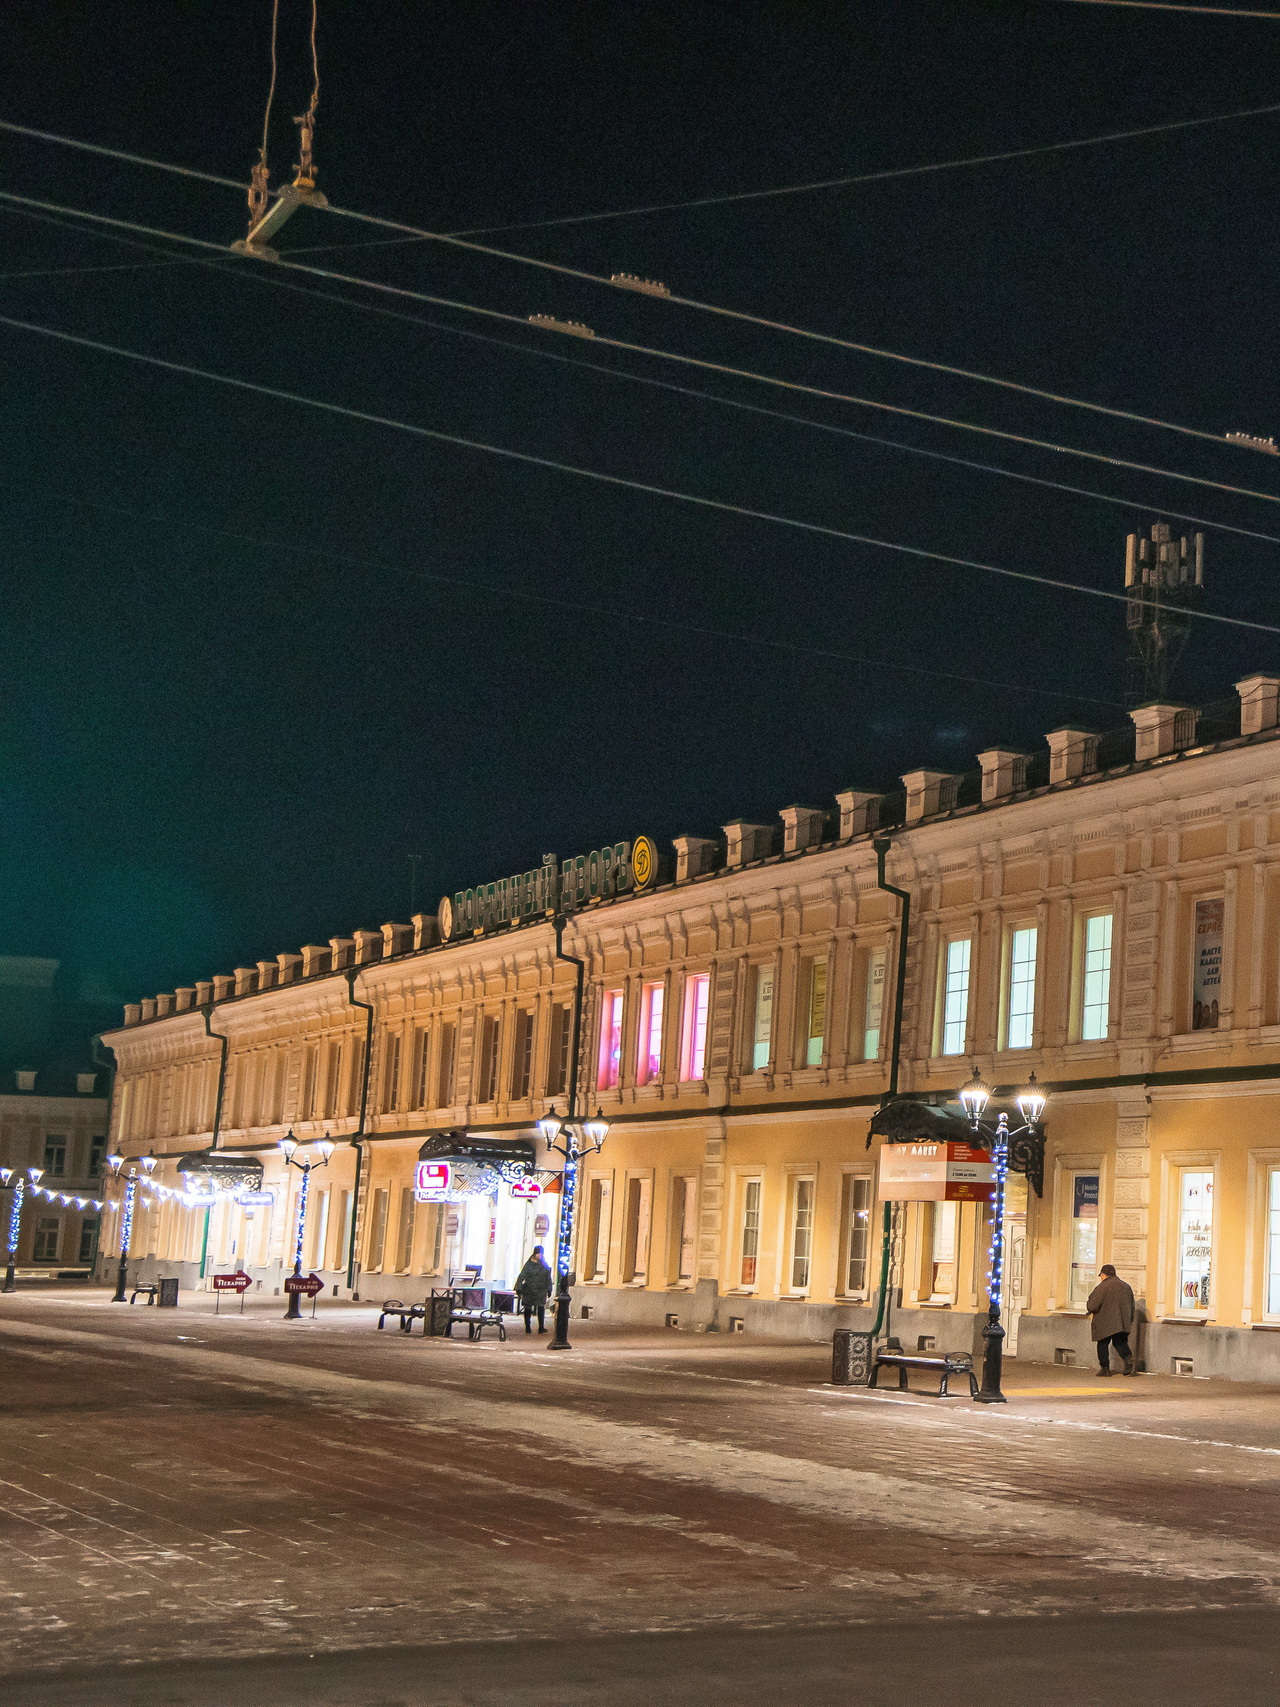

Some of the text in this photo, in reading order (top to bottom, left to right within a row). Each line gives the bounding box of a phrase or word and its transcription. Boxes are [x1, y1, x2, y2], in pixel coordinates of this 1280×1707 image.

[454, 841, 631, 934] ГОСТИНЫЙ ДВОРЪ
[1197, 920, 1224, 935] EXPRE
[1201, 946, 1222, 957] МАСТЕ
